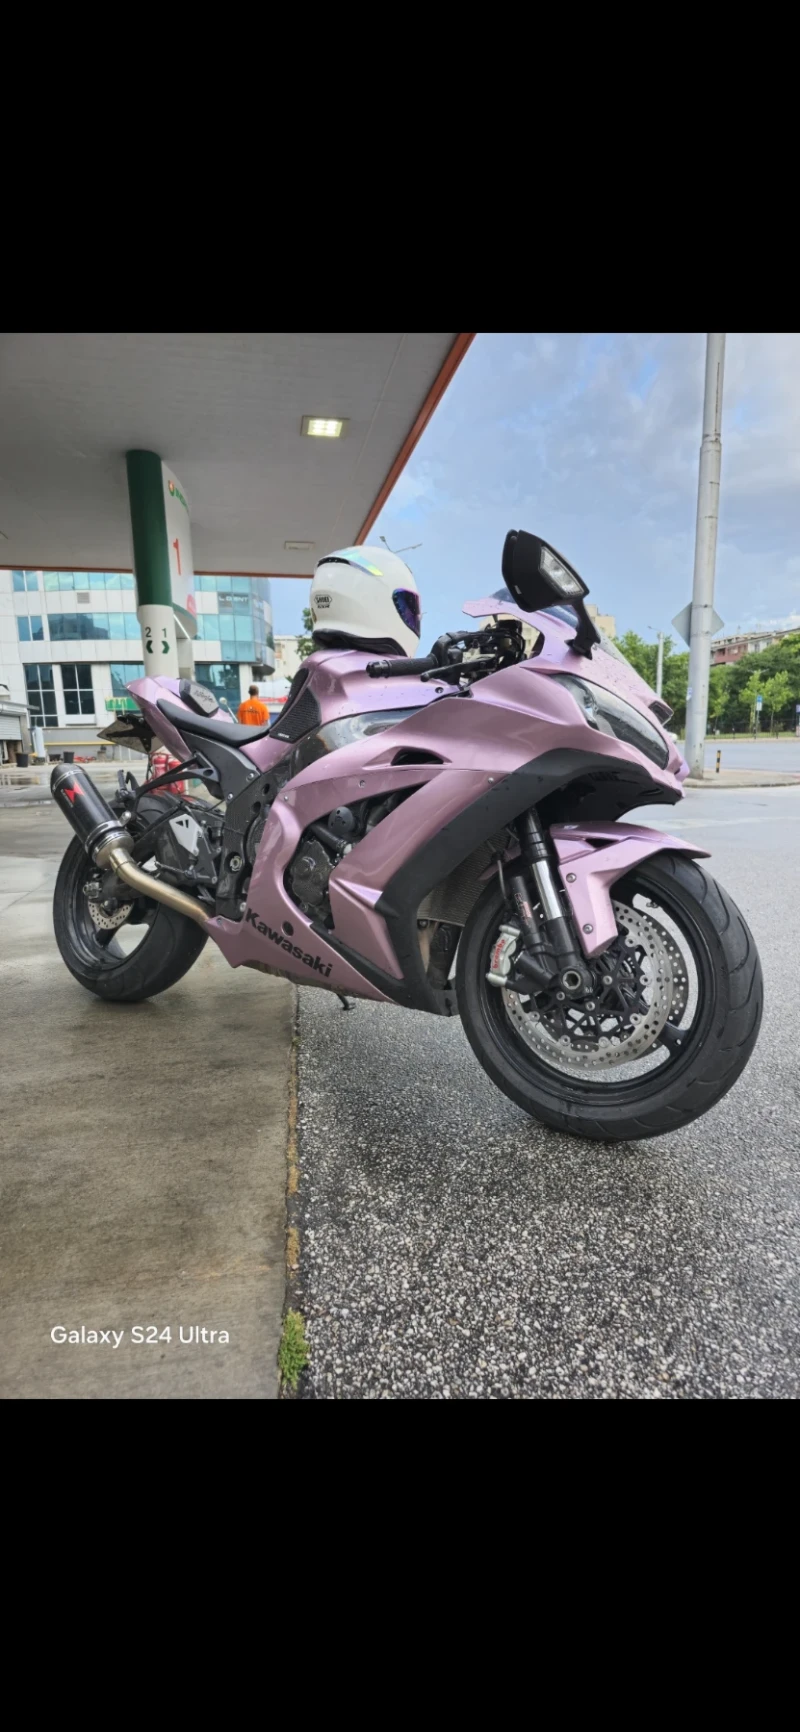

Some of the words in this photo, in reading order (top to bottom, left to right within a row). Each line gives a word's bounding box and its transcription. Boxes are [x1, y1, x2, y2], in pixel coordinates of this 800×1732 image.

[173, 538, 182, 576] 1
[145, 626, 152, 638] 2
[161, 628, 167, 638] 1
[245, 907, 333, 977] Kawasaki
